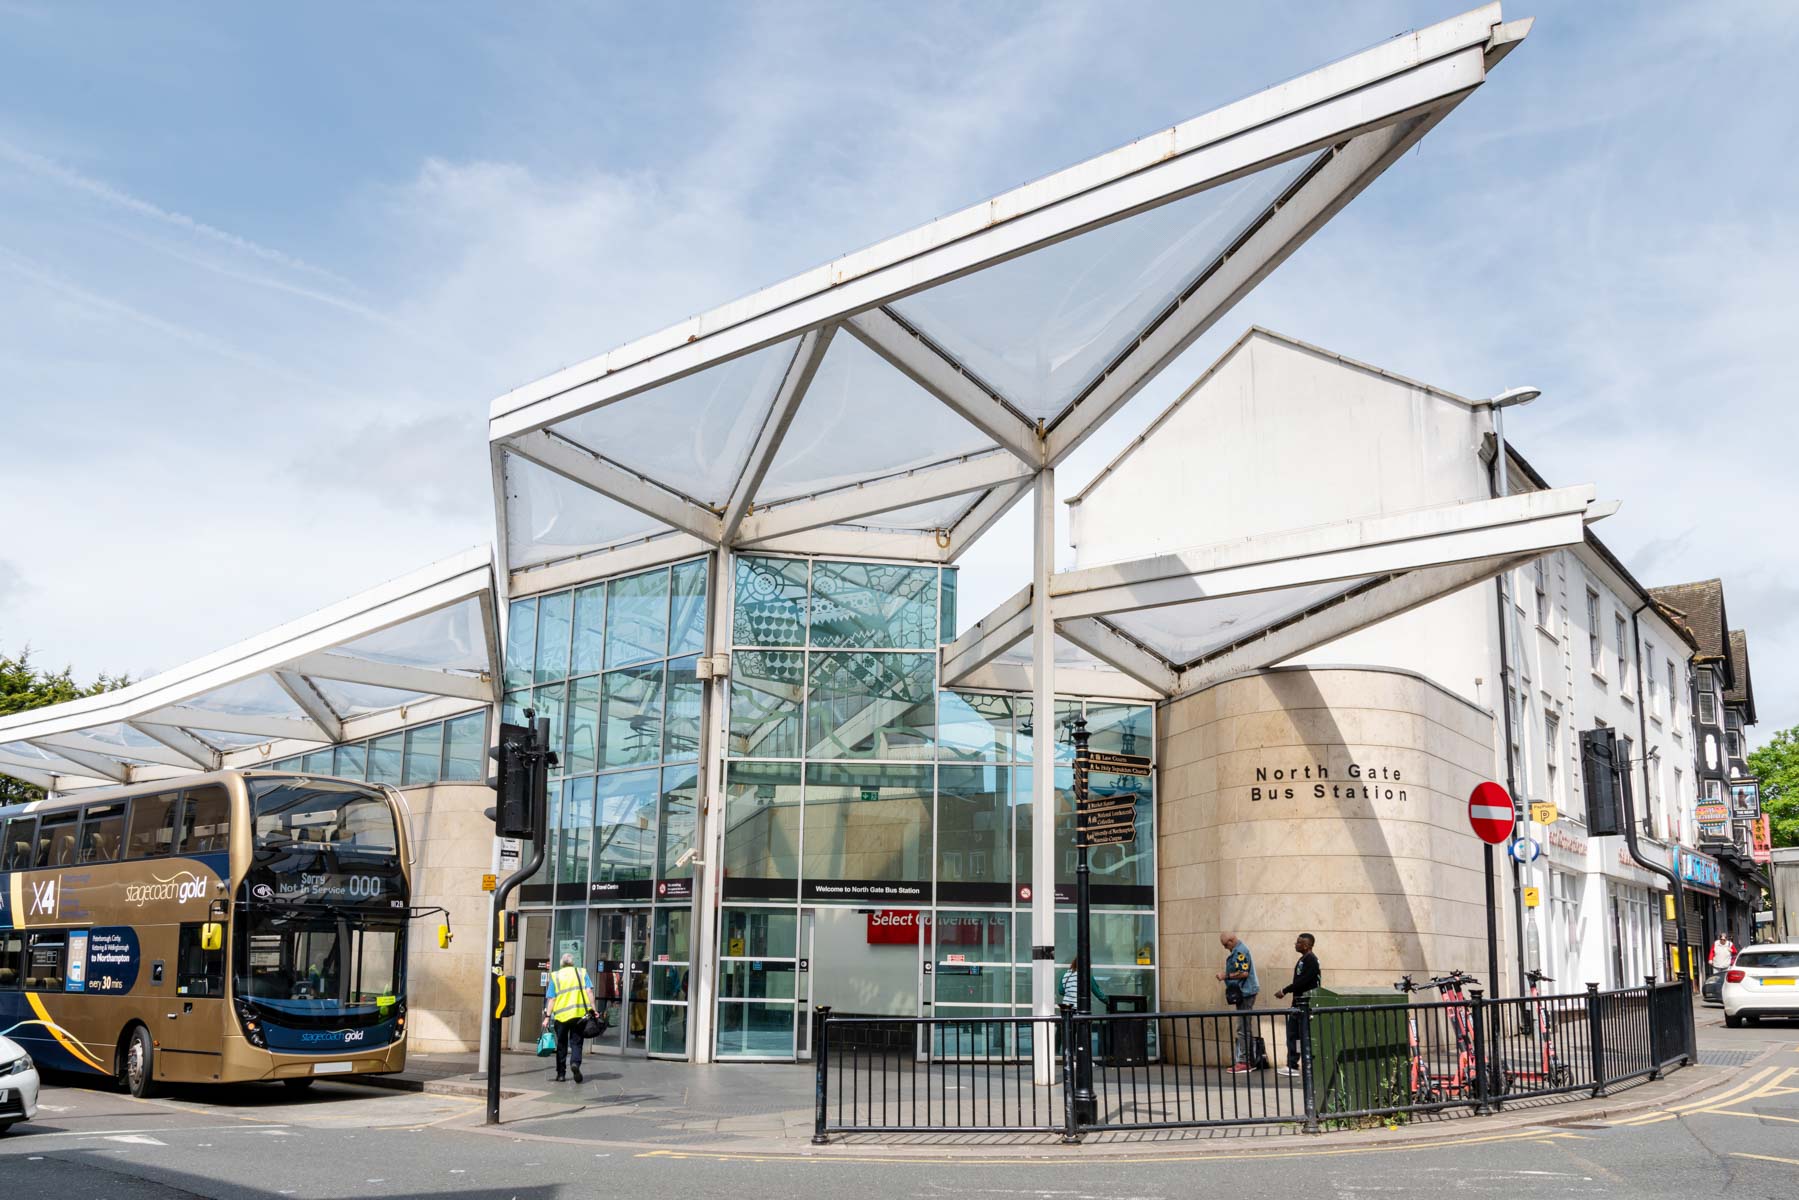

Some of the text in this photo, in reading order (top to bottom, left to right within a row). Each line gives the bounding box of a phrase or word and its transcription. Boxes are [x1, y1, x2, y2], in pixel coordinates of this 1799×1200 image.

[1256, 764, 1401, 782] North Gate
[1251, 784, 1407, 801] Bus Station
[301, 872, 326, 884] Sorry
[350, 875, 381, 896] 000
[125, 876, 207, 907] stagecoach gold
[280, 883, 346, 895] Not In Service
[815, 885, 844, 893] Welcome
[869, 886, 884, 894] Gate
[898, 886, 920, 894] Station
[30, 880, 55, 915] X4
[872, 911, 913, 926] Select
[91, 953, 130, 965] to Northampton
[89, 981, 102, 991] every
[101, 976, 112, 990] 30
[111, 978, 123, 989] mins
[301, 1030, 364, 1044] stagecoach gold
